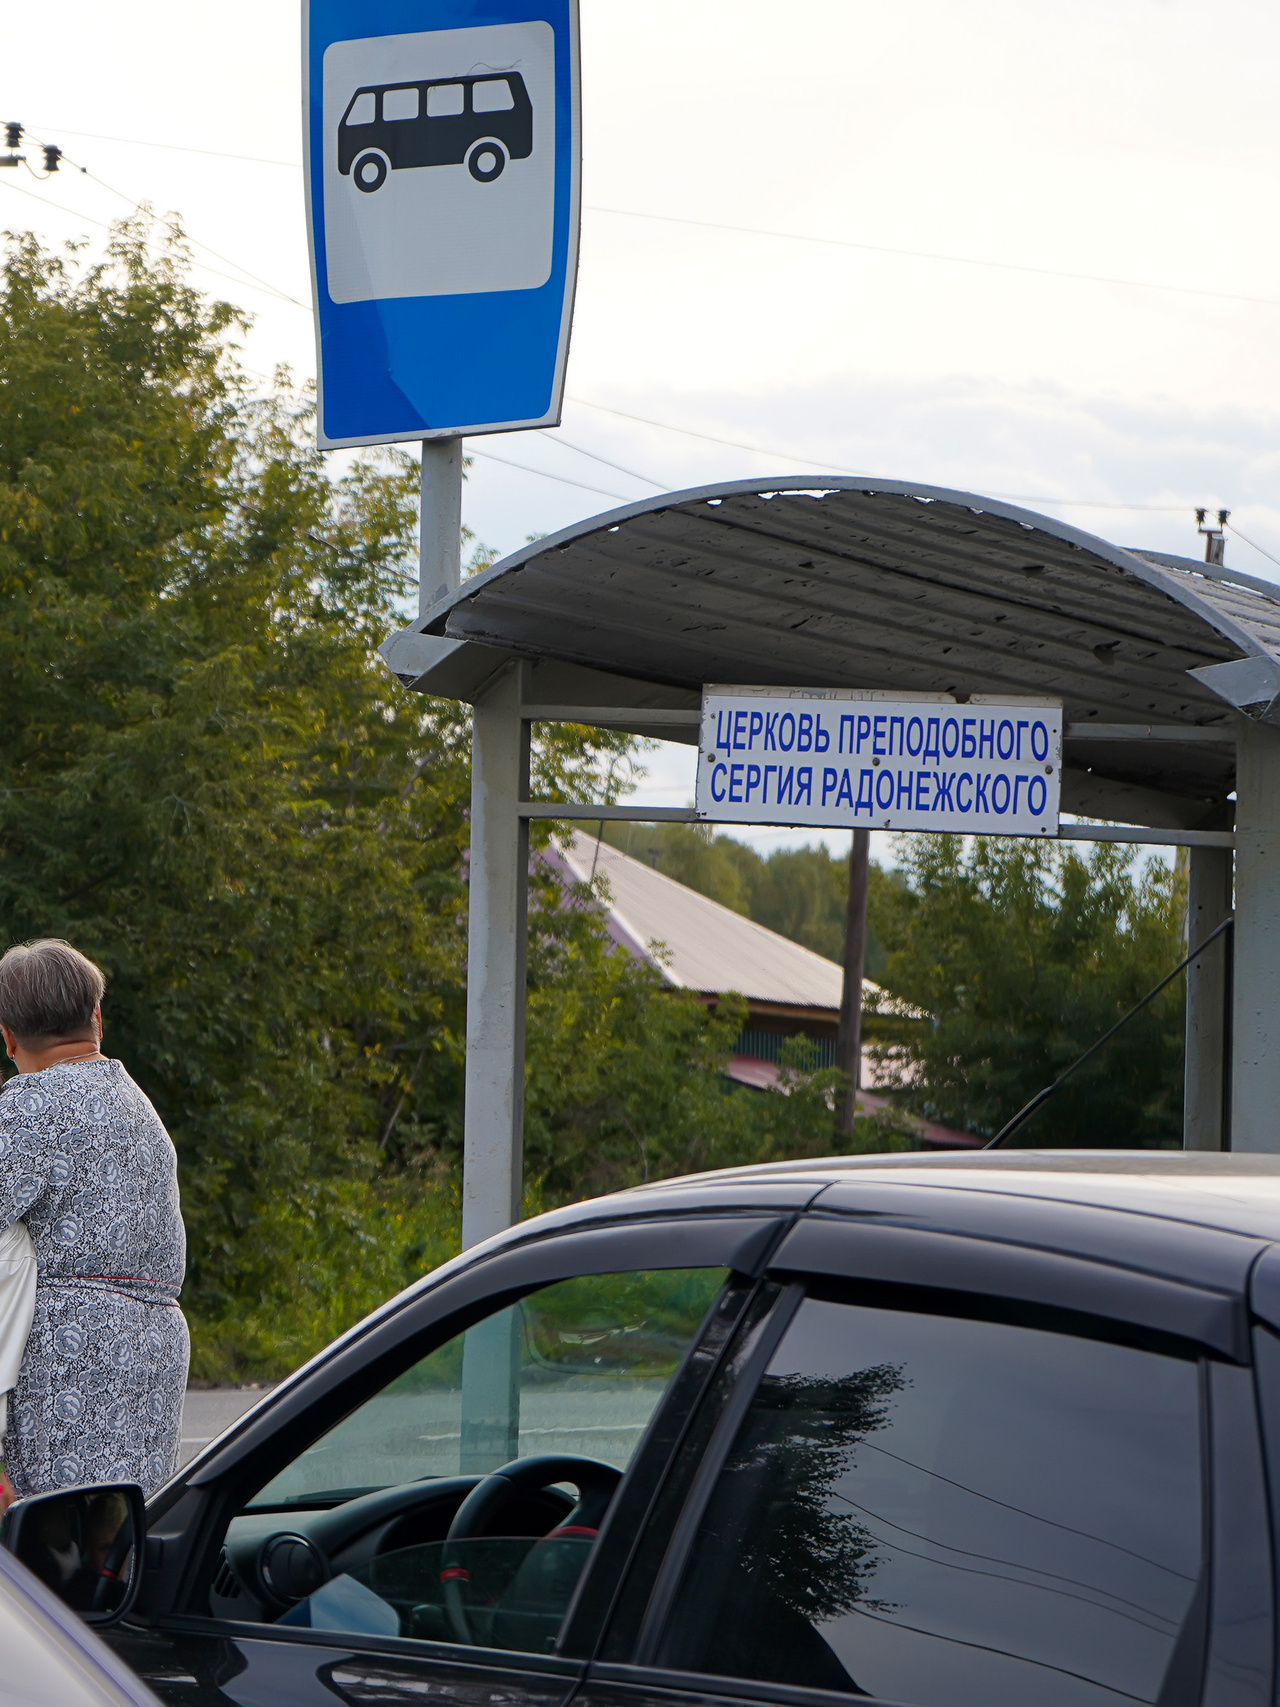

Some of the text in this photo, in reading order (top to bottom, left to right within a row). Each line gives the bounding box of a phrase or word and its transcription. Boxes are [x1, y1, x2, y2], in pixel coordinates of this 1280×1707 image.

[716, 710, 1049, 766] ЦЕРКОВЬ ПРЕПОДОБНОГО
[710, 762, 1047, 817] СЕРГИЯ РАДОНЕЖСКОГО
